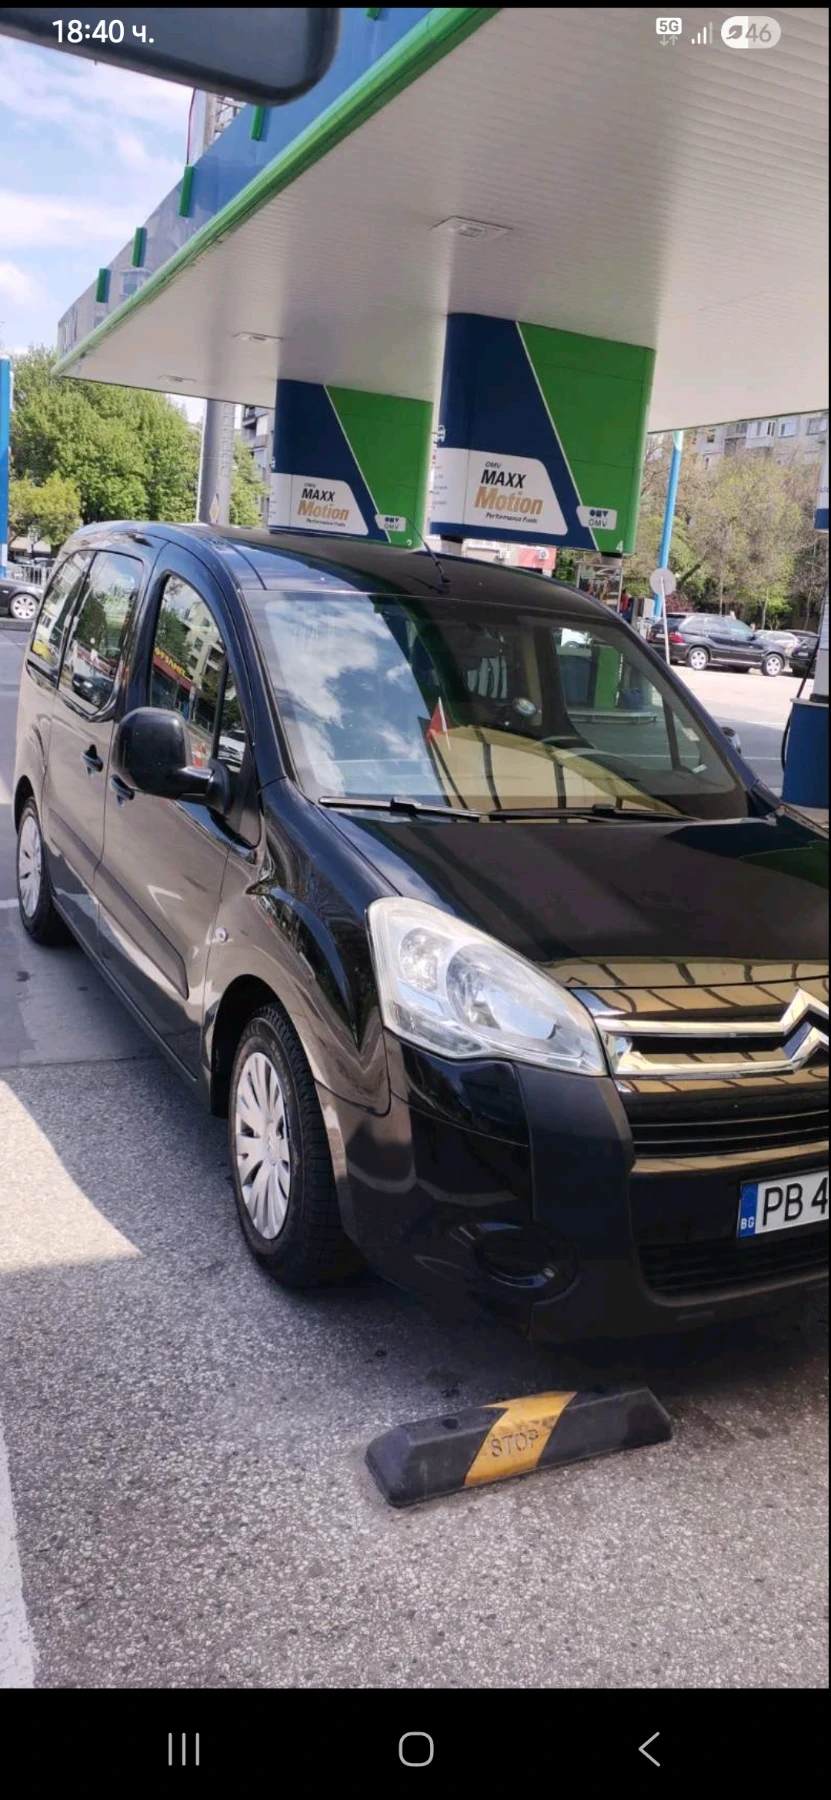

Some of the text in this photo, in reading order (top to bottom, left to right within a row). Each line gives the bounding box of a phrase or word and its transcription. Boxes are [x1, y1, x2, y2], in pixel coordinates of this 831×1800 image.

[485, 461, 502, 469] OMV
[480, 469, 527, 489] MAXX
[301, 488, 336, 502] MAXX
[474, 485, 543, 515] Motion
[297, 499, 349, 521] Motion
[486, 512, 522, 522] Performance
[588, 519, 608, 528] OMV
[762, 1182, 804, 1227] PB
[740, 1216, 755, 1230] BG
[490, 1428, 539, 1458] STOP
